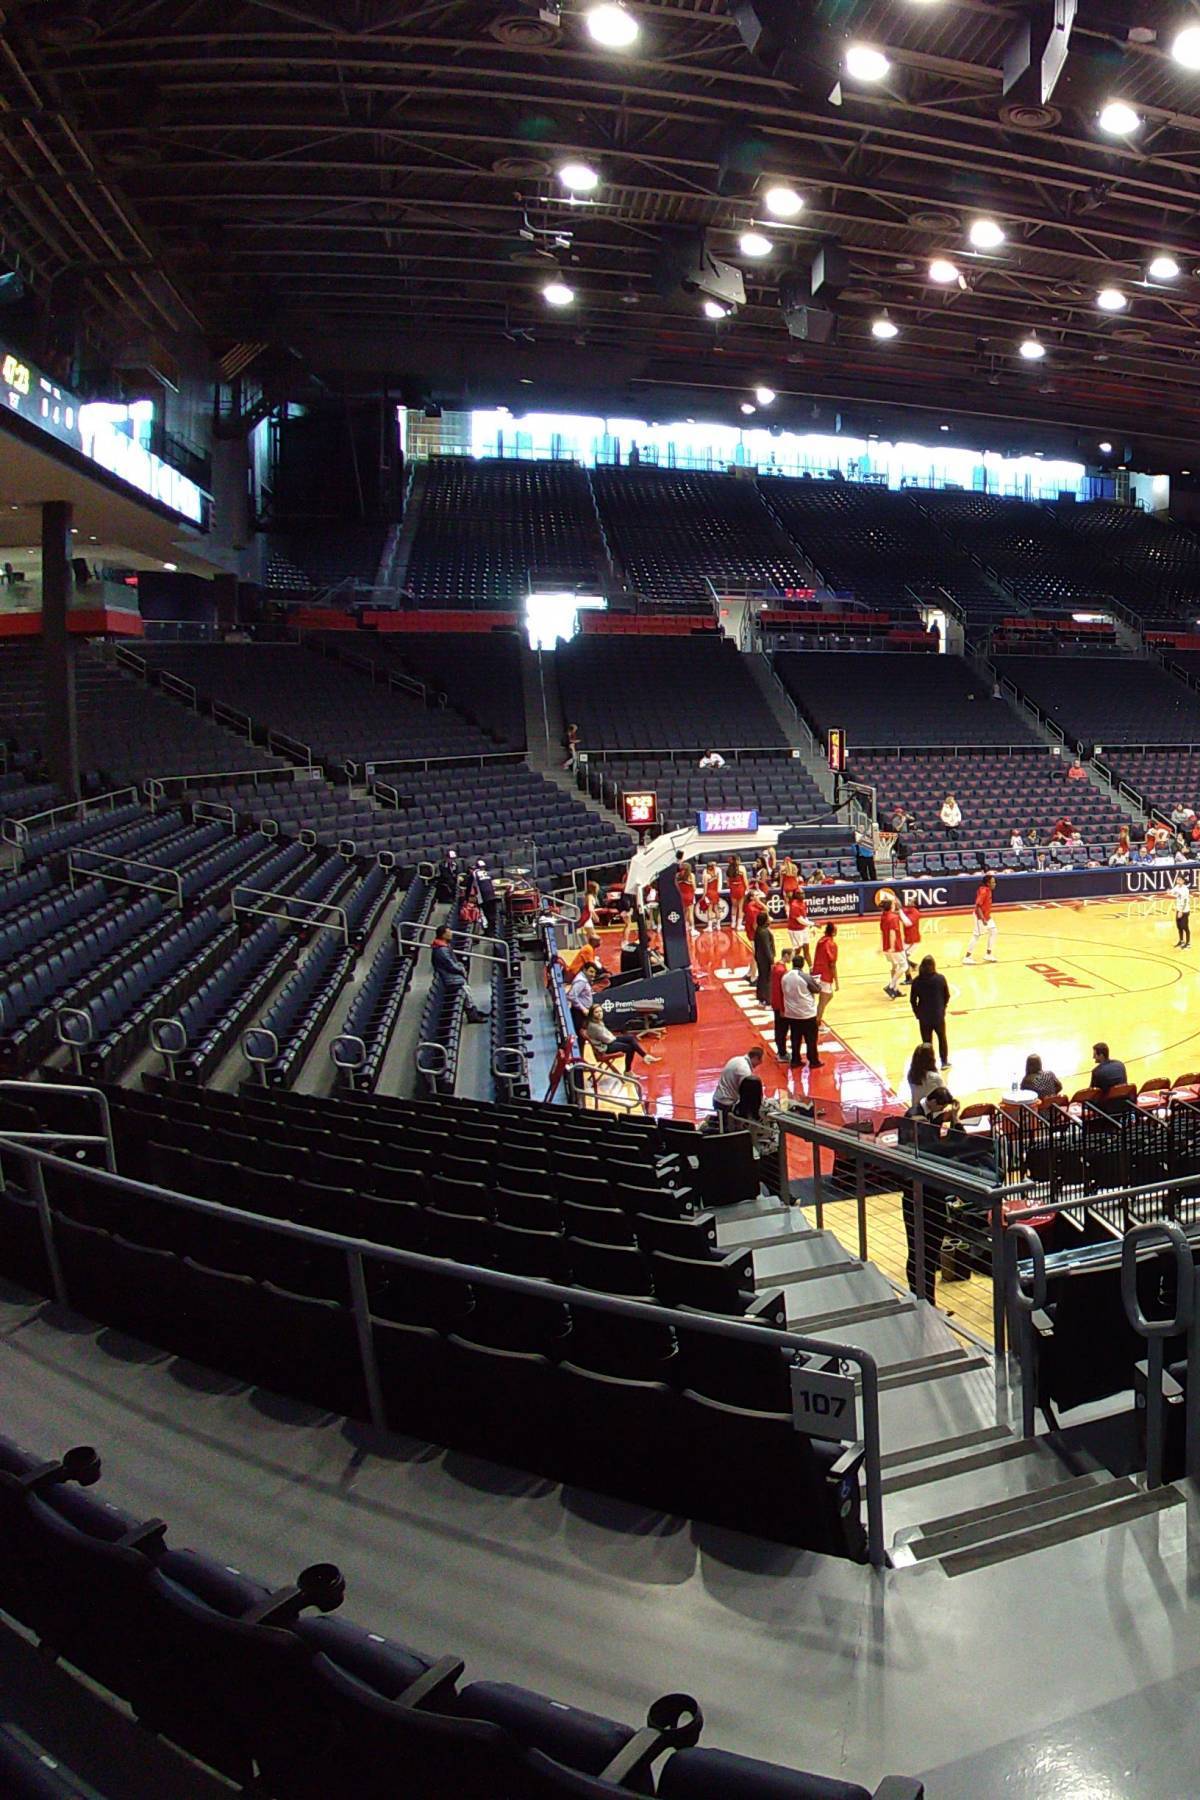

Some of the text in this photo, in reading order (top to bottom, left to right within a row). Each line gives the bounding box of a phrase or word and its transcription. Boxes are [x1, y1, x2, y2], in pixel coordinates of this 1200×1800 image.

[631, 806, 650, 820] 30
[804, 893, 859, 906] mier Health
[901, 887, 948, 906] PNC
[809, 905, 828, 915] Valley
[829, 903, 856, 913] Hospital
[800, 1390, 847, 1418] 107
